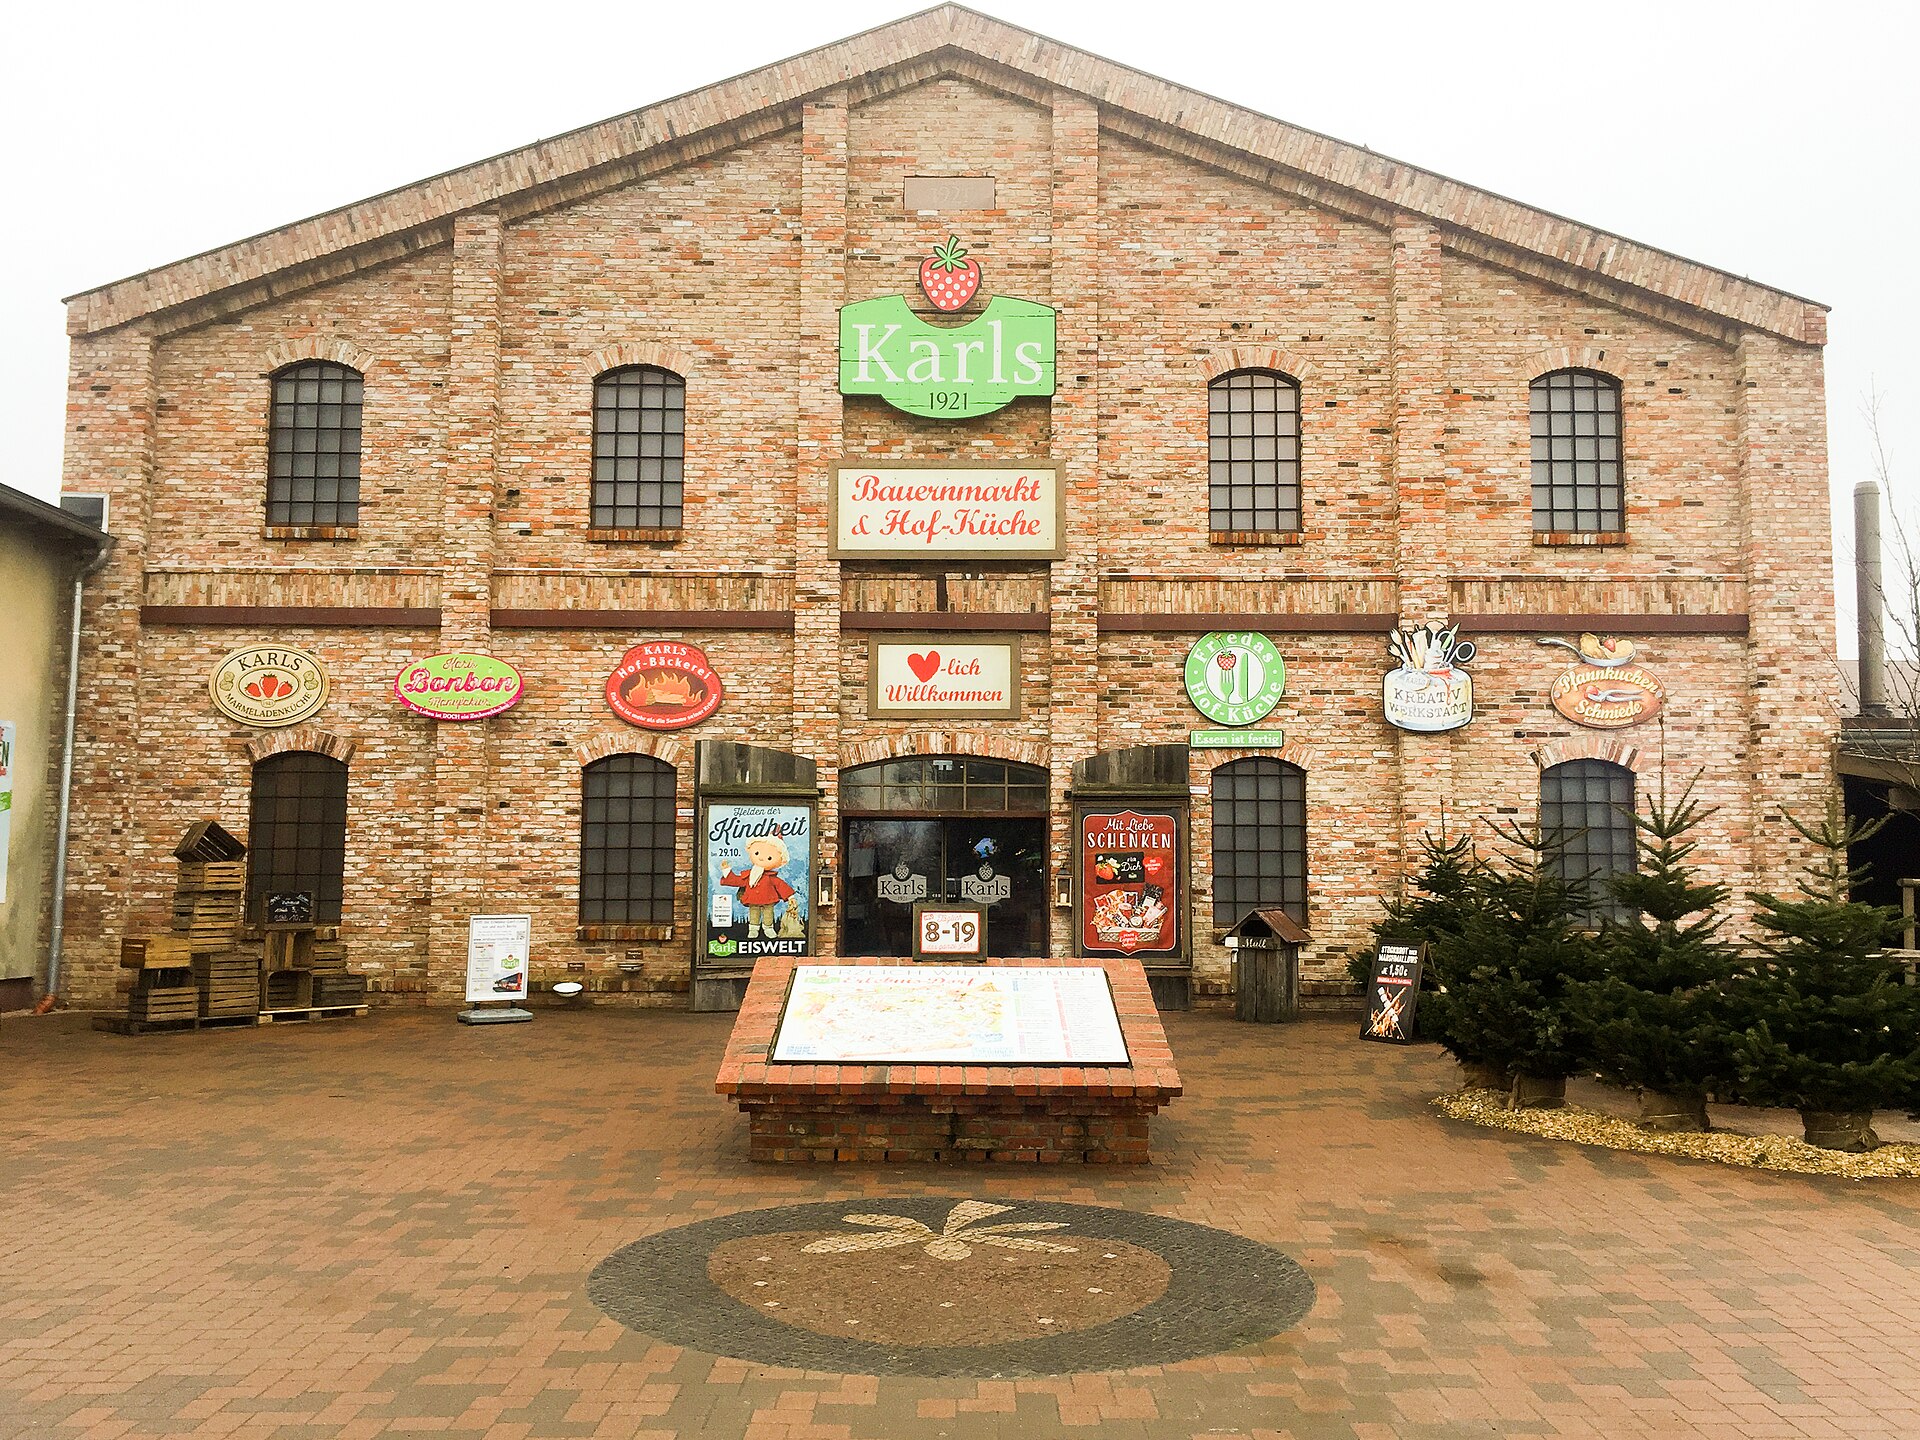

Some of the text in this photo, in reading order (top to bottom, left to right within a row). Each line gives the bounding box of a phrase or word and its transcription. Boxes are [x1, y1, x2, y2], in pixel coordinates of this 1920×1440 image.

[852, 321, 1042, 386] Karls
[929, 392, 968, 411] 1921
[852, 475, 1041, 503] Bauernmarkt
[852, 509, 1041, 543] & Hof-Küche
[644, 645, 687, 656] KARLS
[237, 653, 303, 671] KARLS
[617, 656, 712, 680] Hof-Bäckerei
[403, 668, 517, 693] Bonbon
[1560, 667, 1659, 693] Pfannkuchen
[885, 684, 1003, 703] Willkommen
[1190, 681, 1281, 722] Hof-Küche
[225, 693, 312, 718] MARMELADENKÜCHE
[1389, 702, 1467, 718] WERKSTATT
[1574, 700, 1643, 719] Schmiede
[1194, 733, 1279, 746] Essen ist fertig
[733, 807, 782, 816] Helden der
[709, 816, 808, 845] Kindheit
[1103, 818, 1154, 833] Mit Liebe
[1087, 832, 1171, 849] SCHENKEN
[719, 848, 741, 857] 29.10.
[1121, 860, 1142, 871] Dich
[880, 880, 924, 895] Karls
[964, 880, 1008, 895] Karls
[925, 921, 976, 942] 8-19
[710, 941, 806, 954] Karls EISWELT
[1378, 954, 1418, 964] MARSHMALLOWS
